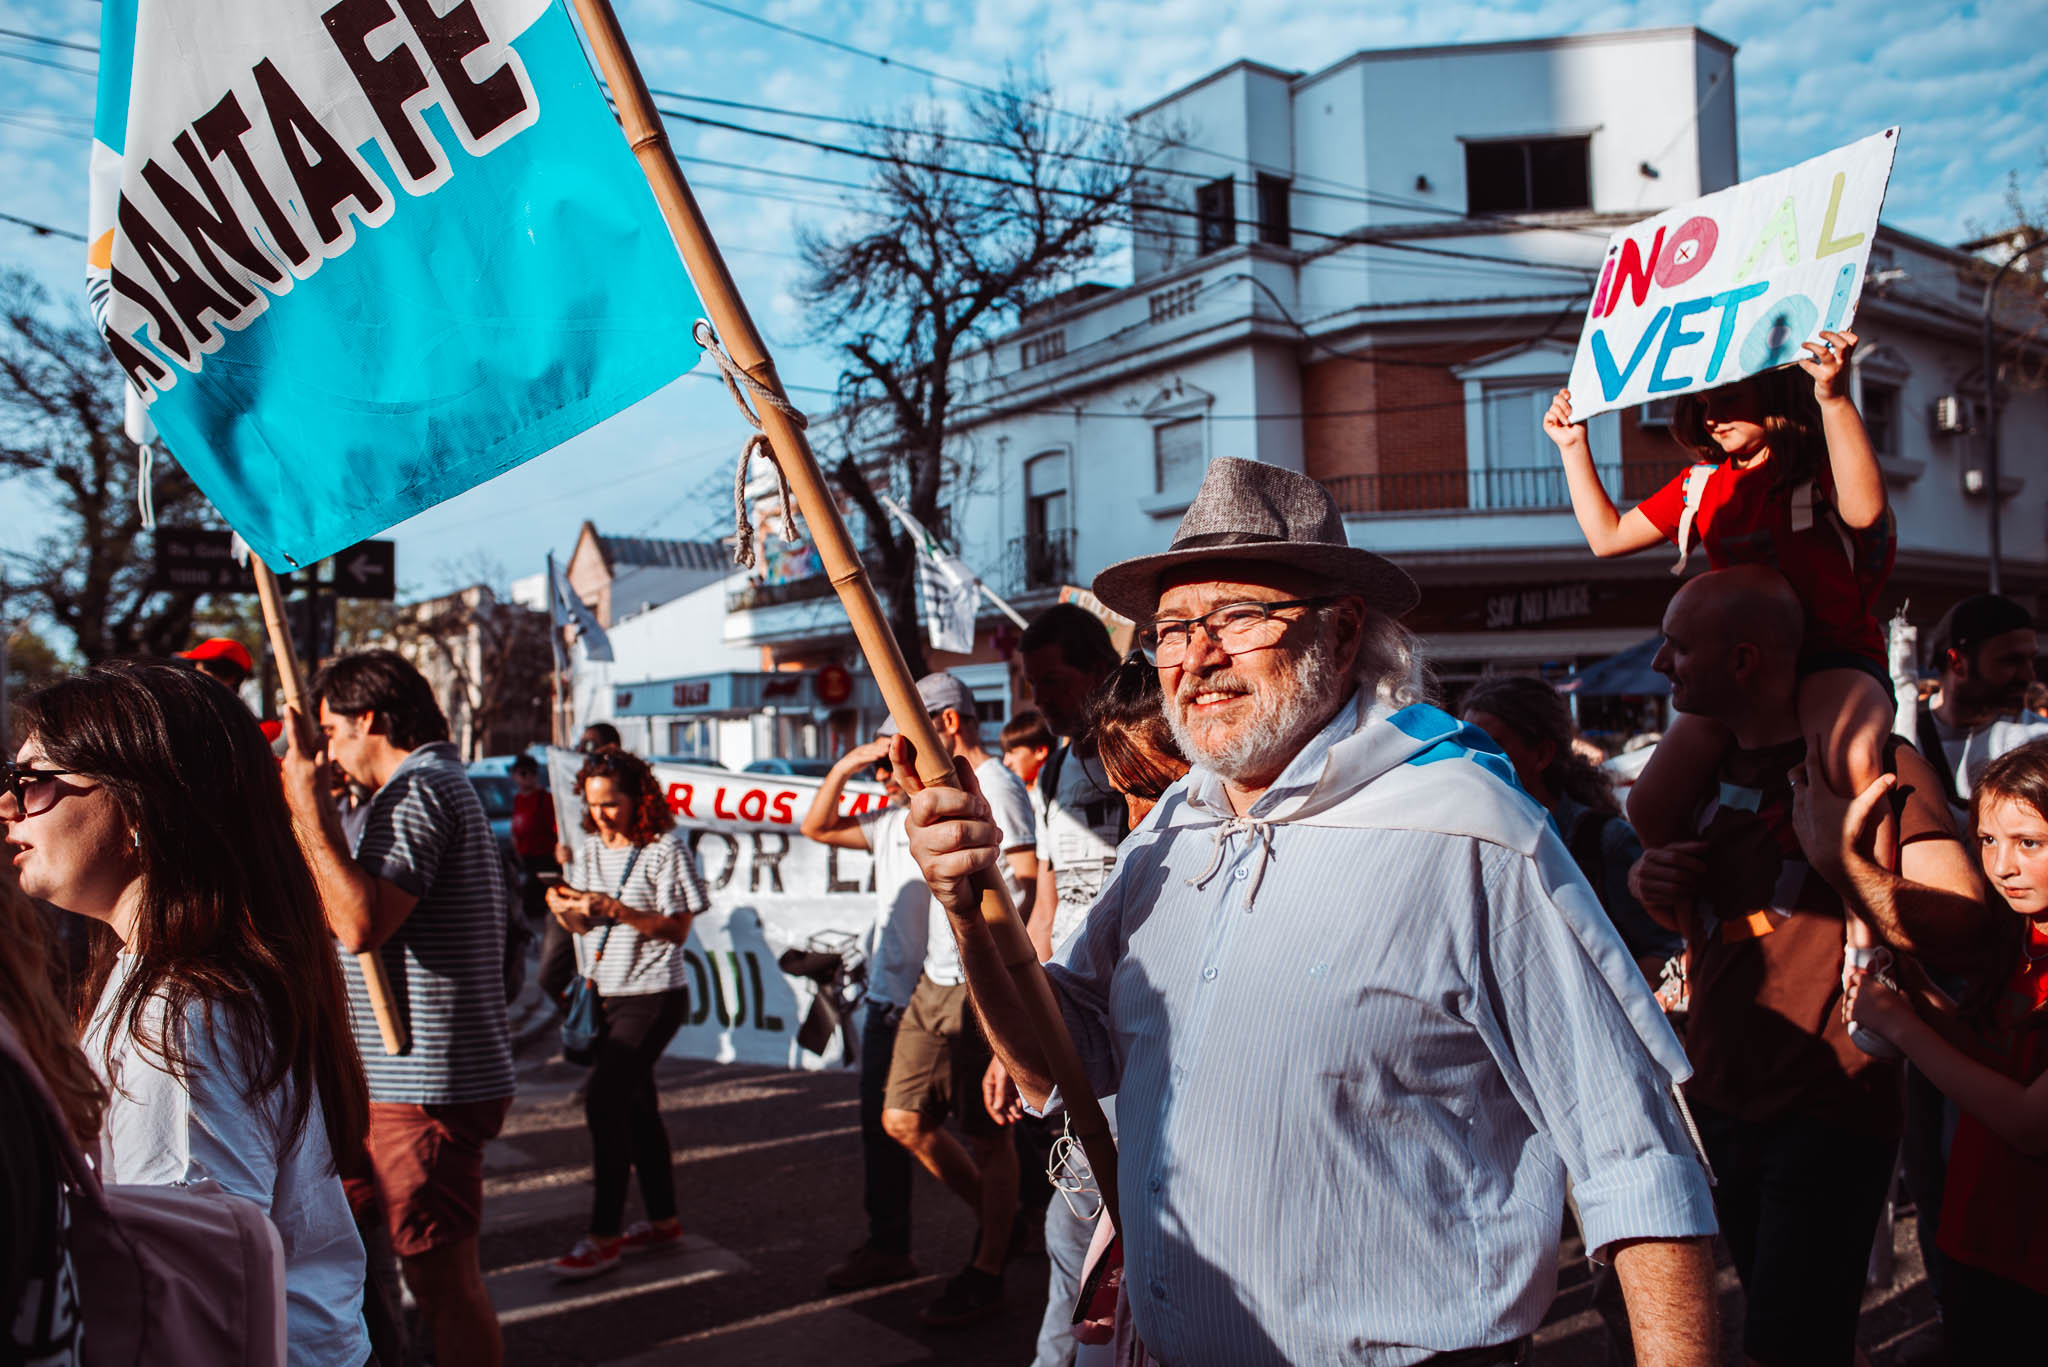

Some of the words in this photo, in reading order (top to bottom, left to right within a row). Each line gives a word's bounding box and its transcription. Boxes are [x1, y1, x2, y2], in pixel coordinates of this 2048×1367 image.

[111, 57, 384, 364] SANTA
[321, 0, 528, 181] FE
[1733, 172, 1865, 283] AL
[1521, 591, 1544, 624] NO
[714, 787, 797, 824] LOS
